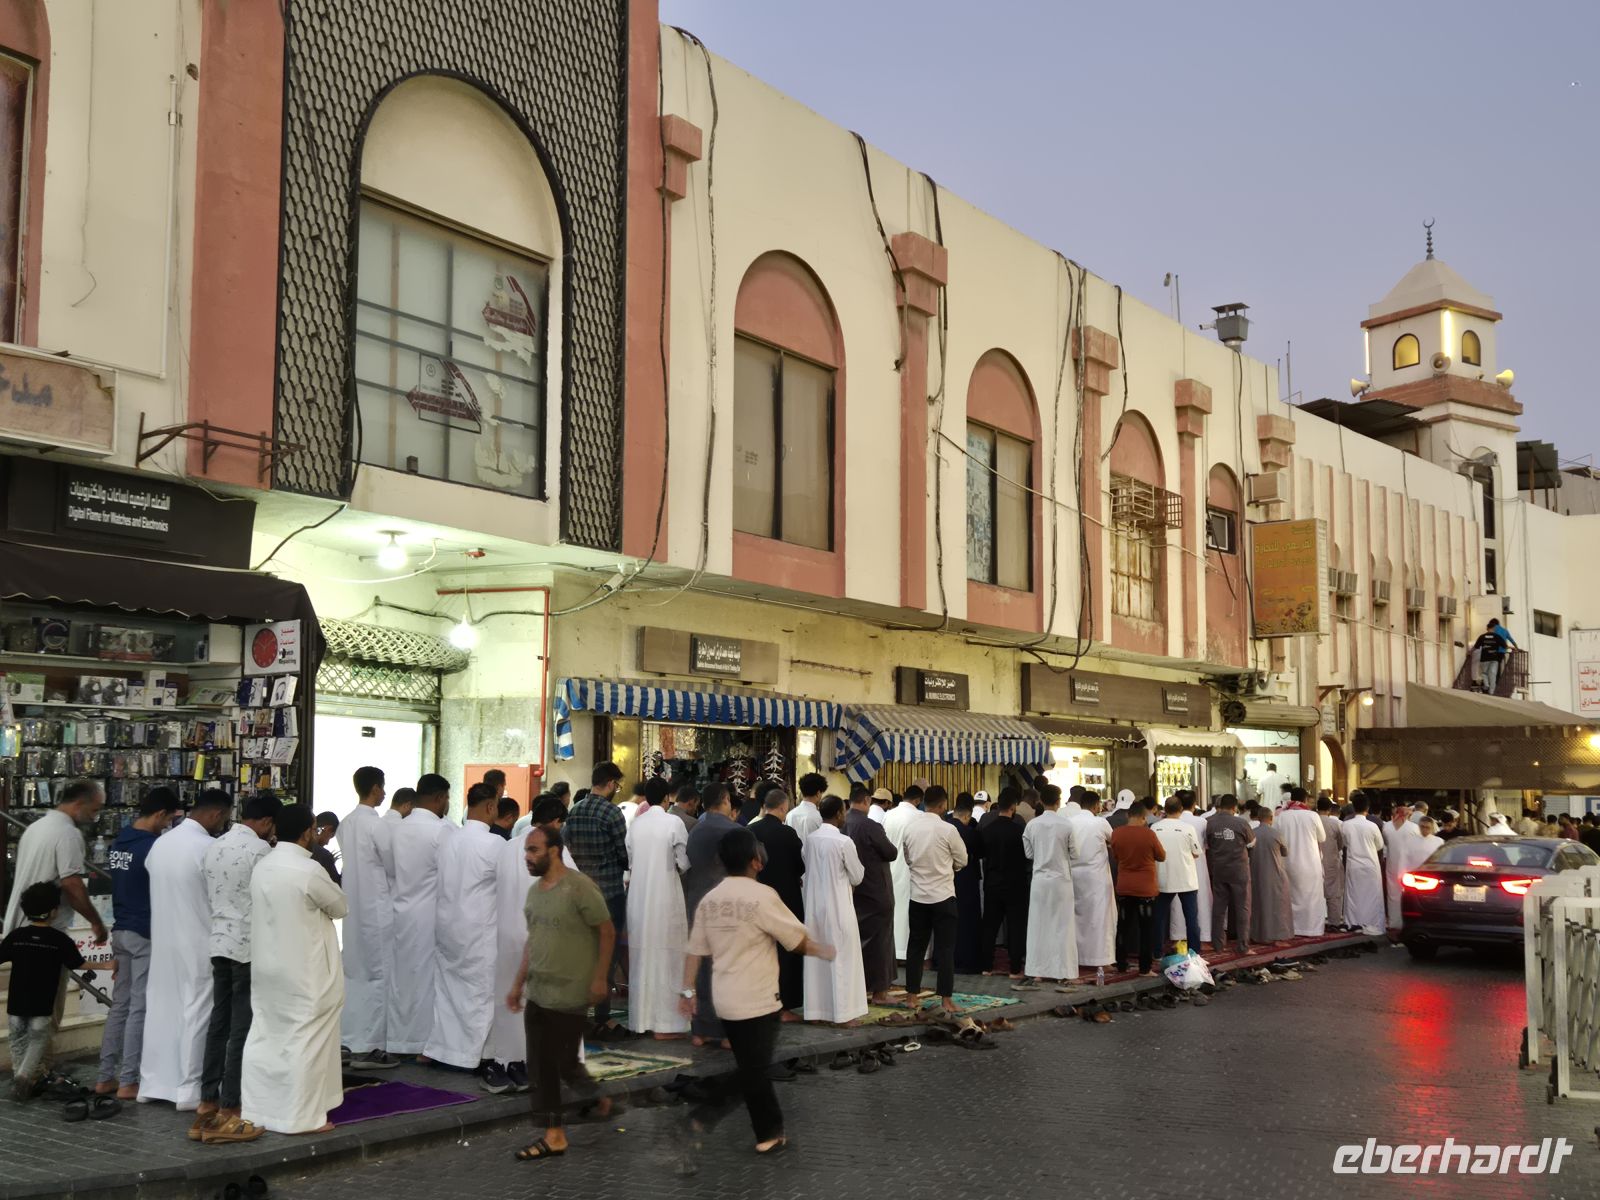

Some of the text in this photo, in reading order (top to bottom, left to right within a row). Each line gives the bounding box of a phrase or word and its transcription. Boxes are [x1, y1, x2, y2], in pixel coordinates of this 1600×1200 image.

[68, 505, 86, 521] Digital
[102, 509, 111, 523] for
[110, 511, 132, 527] Watches
[131, 516, 142, 528] and
[141, 516, 169, 532] Electronics
